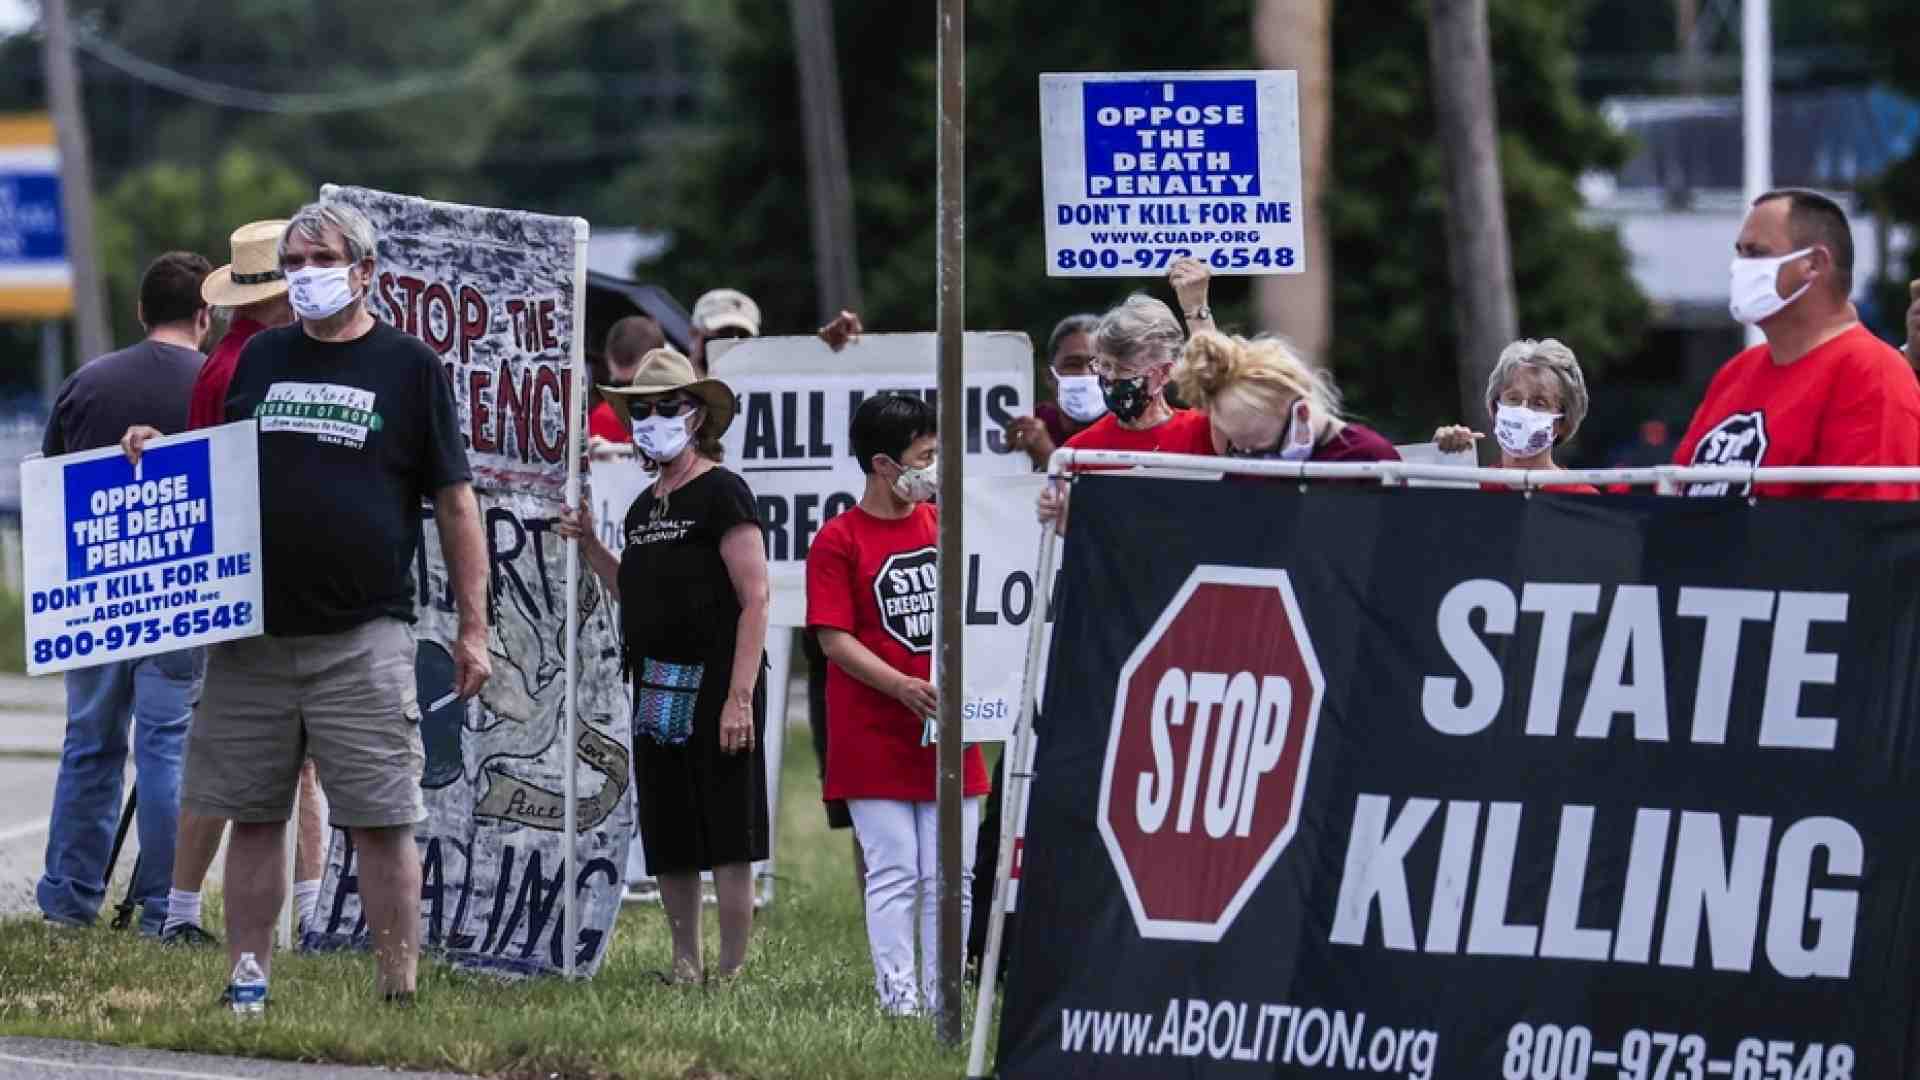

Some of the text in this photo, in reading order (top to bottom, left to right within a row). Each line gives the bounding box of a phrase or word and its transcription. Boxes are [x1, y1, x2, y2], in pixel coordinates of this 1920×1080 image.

[1163, 83, 1174, 101] I
[1096, 105, 1244, 127] OPPOSE
[1113, 152, 1230, 171] DEATH
[1136, 130, 1205, 149] THE
[1090, 174, 1254, 195] PENALTY
[1057, 202, 1292, 225] DON'T KILL FOR ME
[1091, 230, 1261, 244] WWW.CUADP.ORG
[376, 271, 490, 365] STOP
[507, 299, 558, 351] THE
[964, 385, 1020, 455] IS
[91, 474, 189, 516] OPPOSE
[72, 498, 207, 546] THE DEATH
[86, 527, 195, 570] PENALTY
[32, 553, 252, 615] DON'T KILL FOR ME
[888, 562, 937, 594] STO
[34, 601, 253, 664] 800-973-6548
[904, 613, 931, 637] NO
[1421, 578, 1850, 750] STATE
[1135, 667, 1293, 839] STOP
[326, 829, 619, 970] HALING
[1328, 793, 1865, 980] KILLING
[1059, 998, 1439, 1080] www.ABOLITION.org
[1501, 1021, 1856, 1080] 800-973-6548
